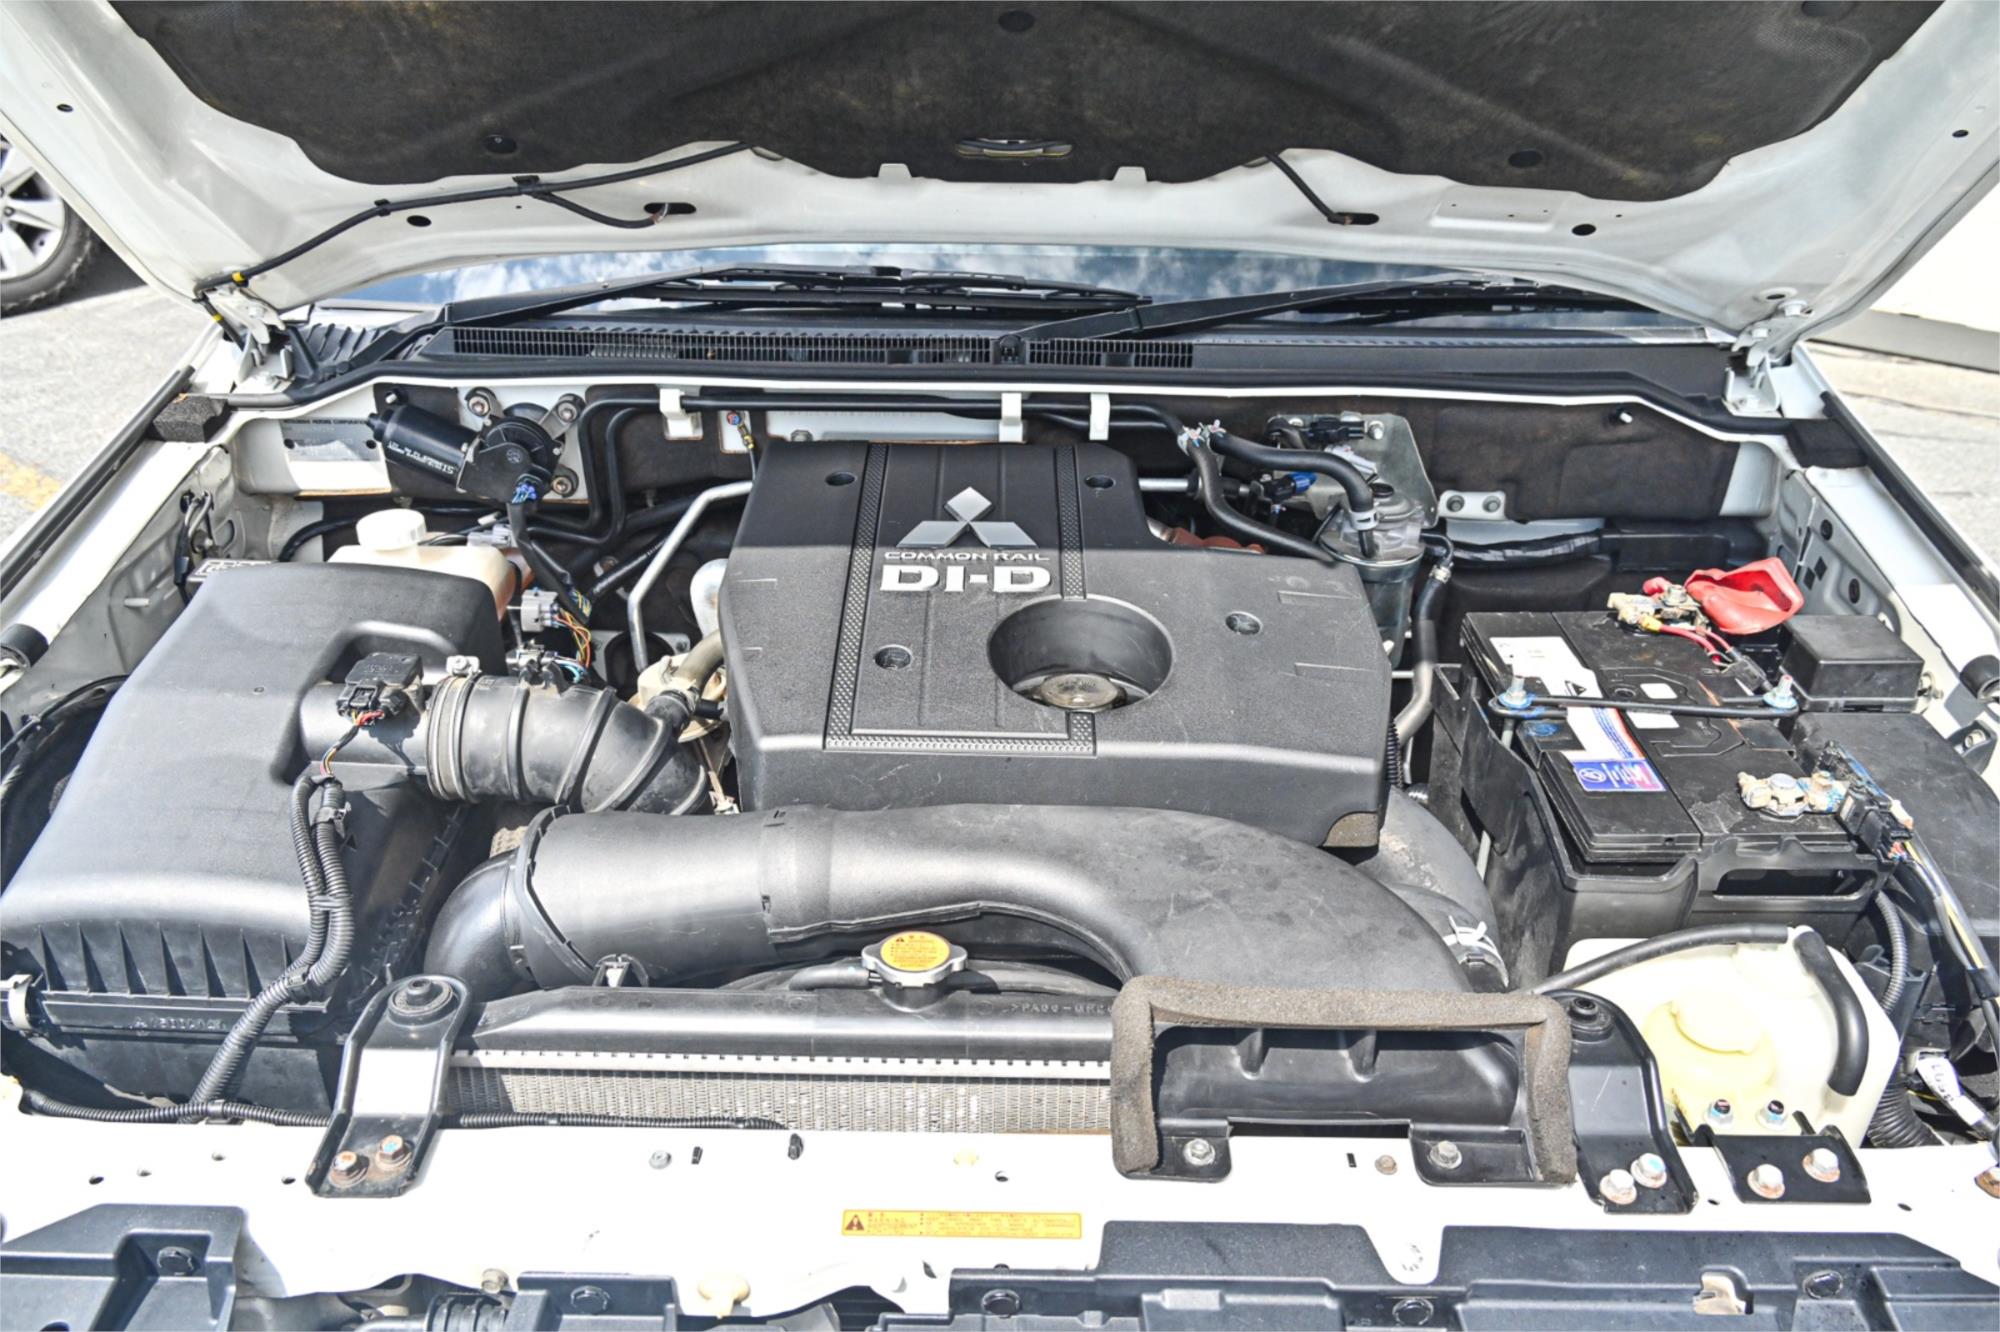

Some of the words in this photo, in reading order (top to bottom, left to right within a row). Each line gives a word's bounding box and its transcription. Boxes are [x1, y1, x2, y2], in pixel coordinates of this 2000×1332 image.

[884, 551, 988, 561] COMMON
[993, 552, 1051, 562] RAIL
[879, 564, 1052, 593] DI-D
